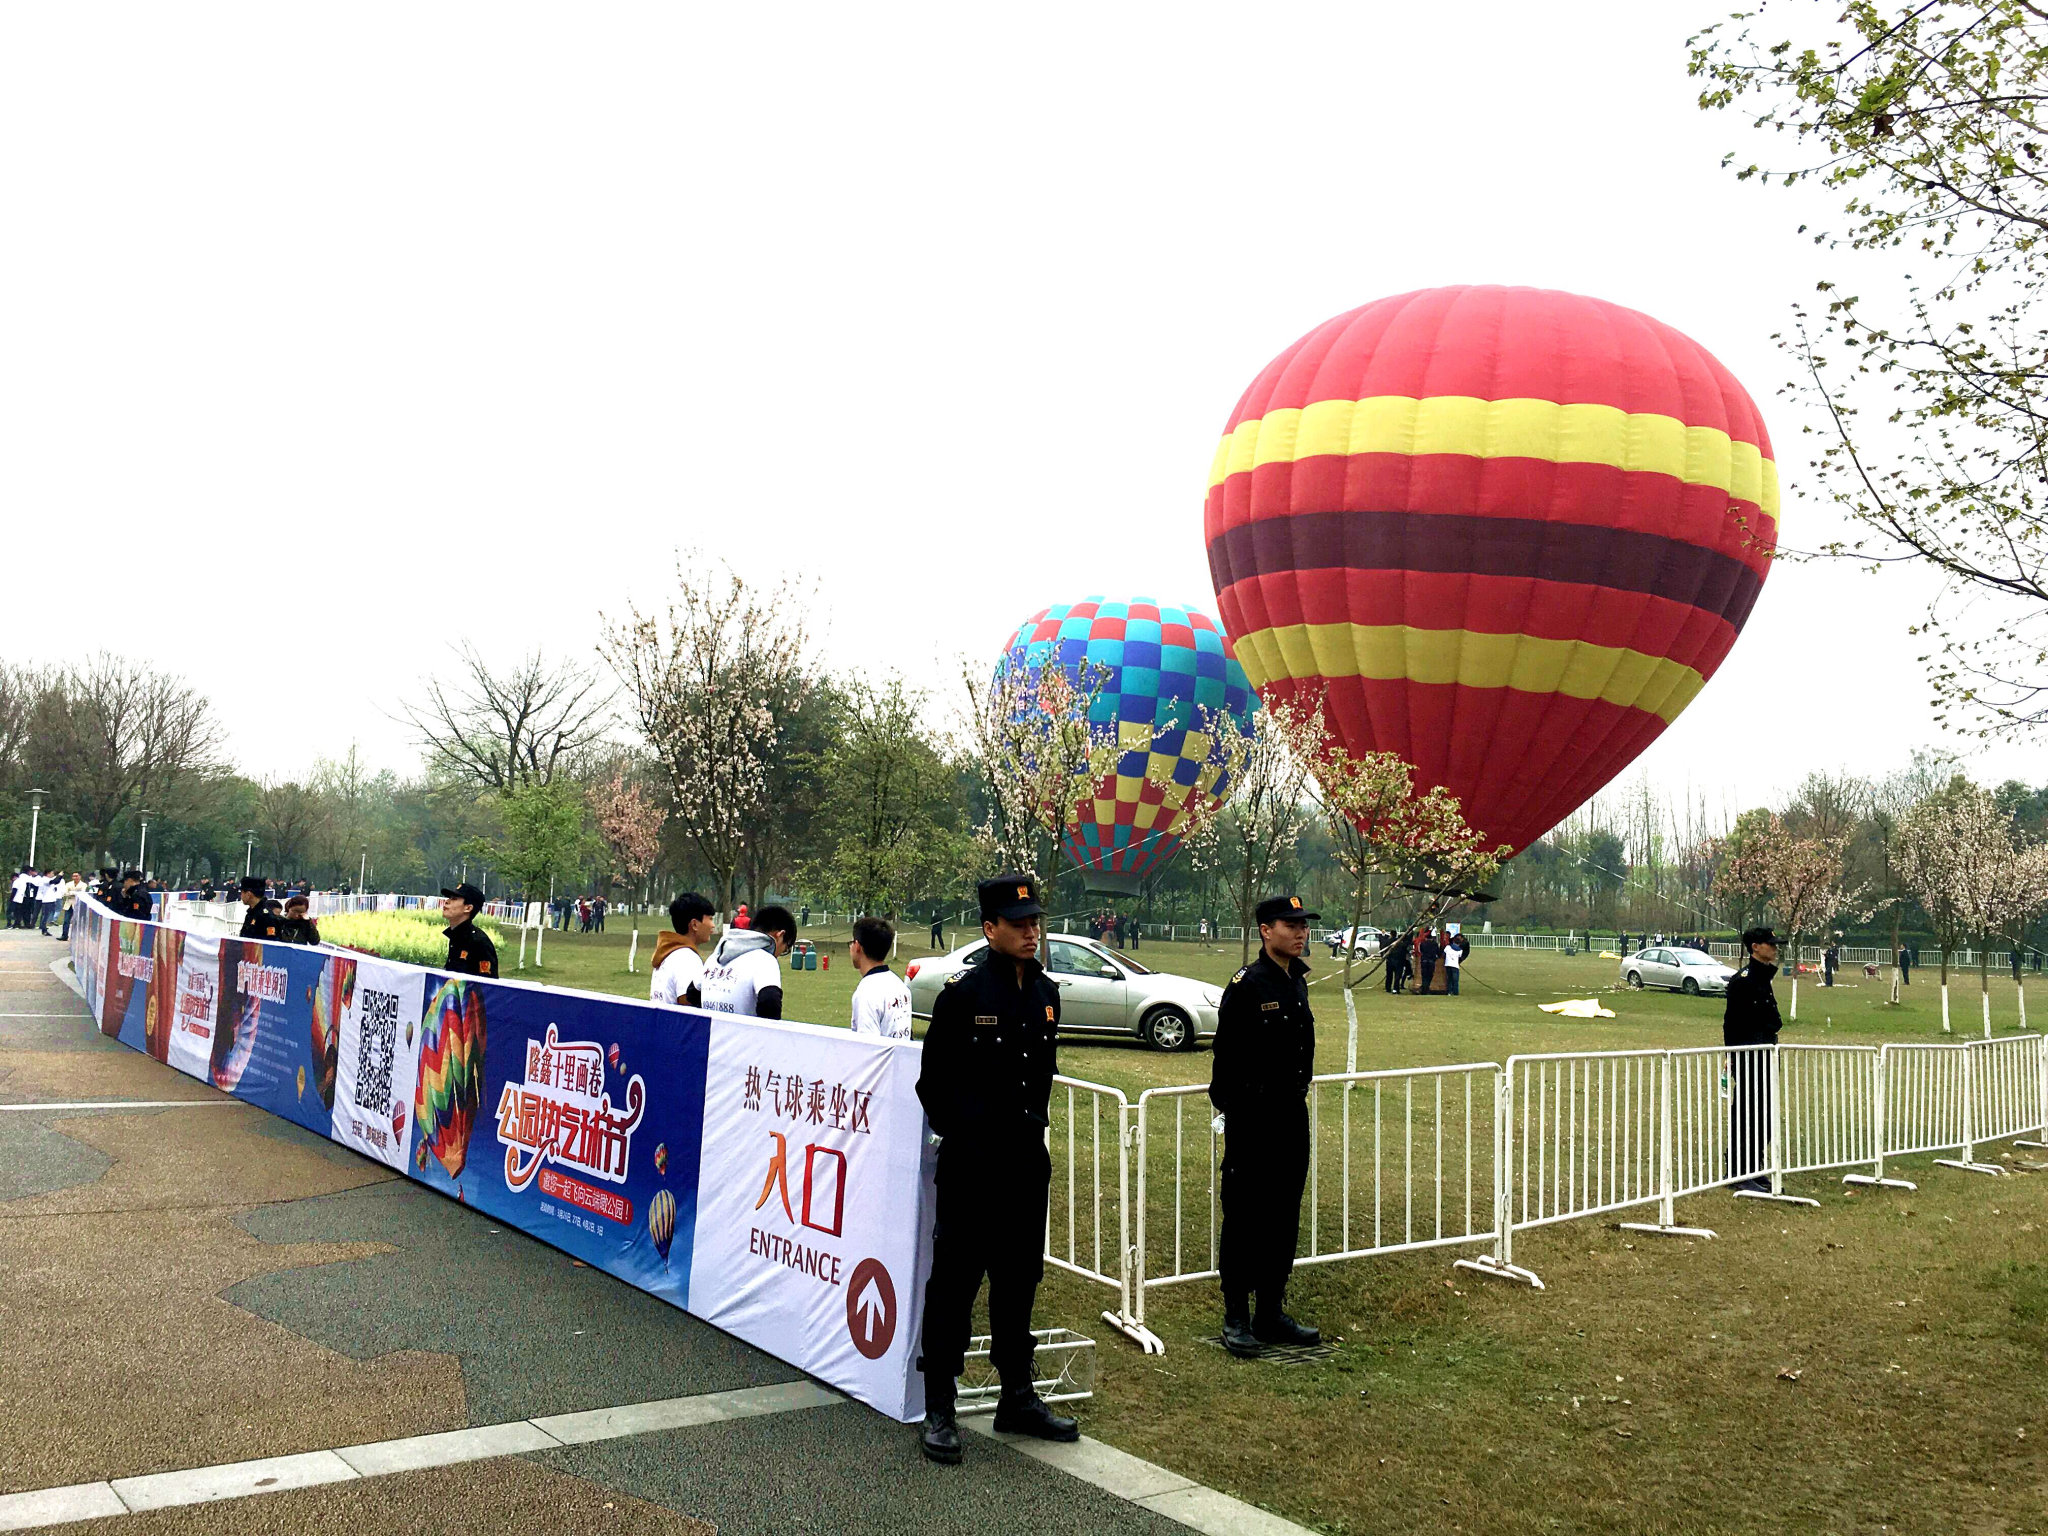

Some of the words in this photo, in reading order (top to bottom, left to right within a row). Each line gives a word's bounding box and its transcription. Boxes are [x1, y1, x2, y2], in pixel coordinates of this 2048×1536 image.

[527, 1045, 602, 1098] 隆鑫十里画卷
[743, 1064, 873, 1135] 热气球乘坐区
[499, 1087, 628, 1176] 公园热气球节
[755, 1130, 847, 1238] 入口
[749, 1227, 842, 1286] ENTRANCE
